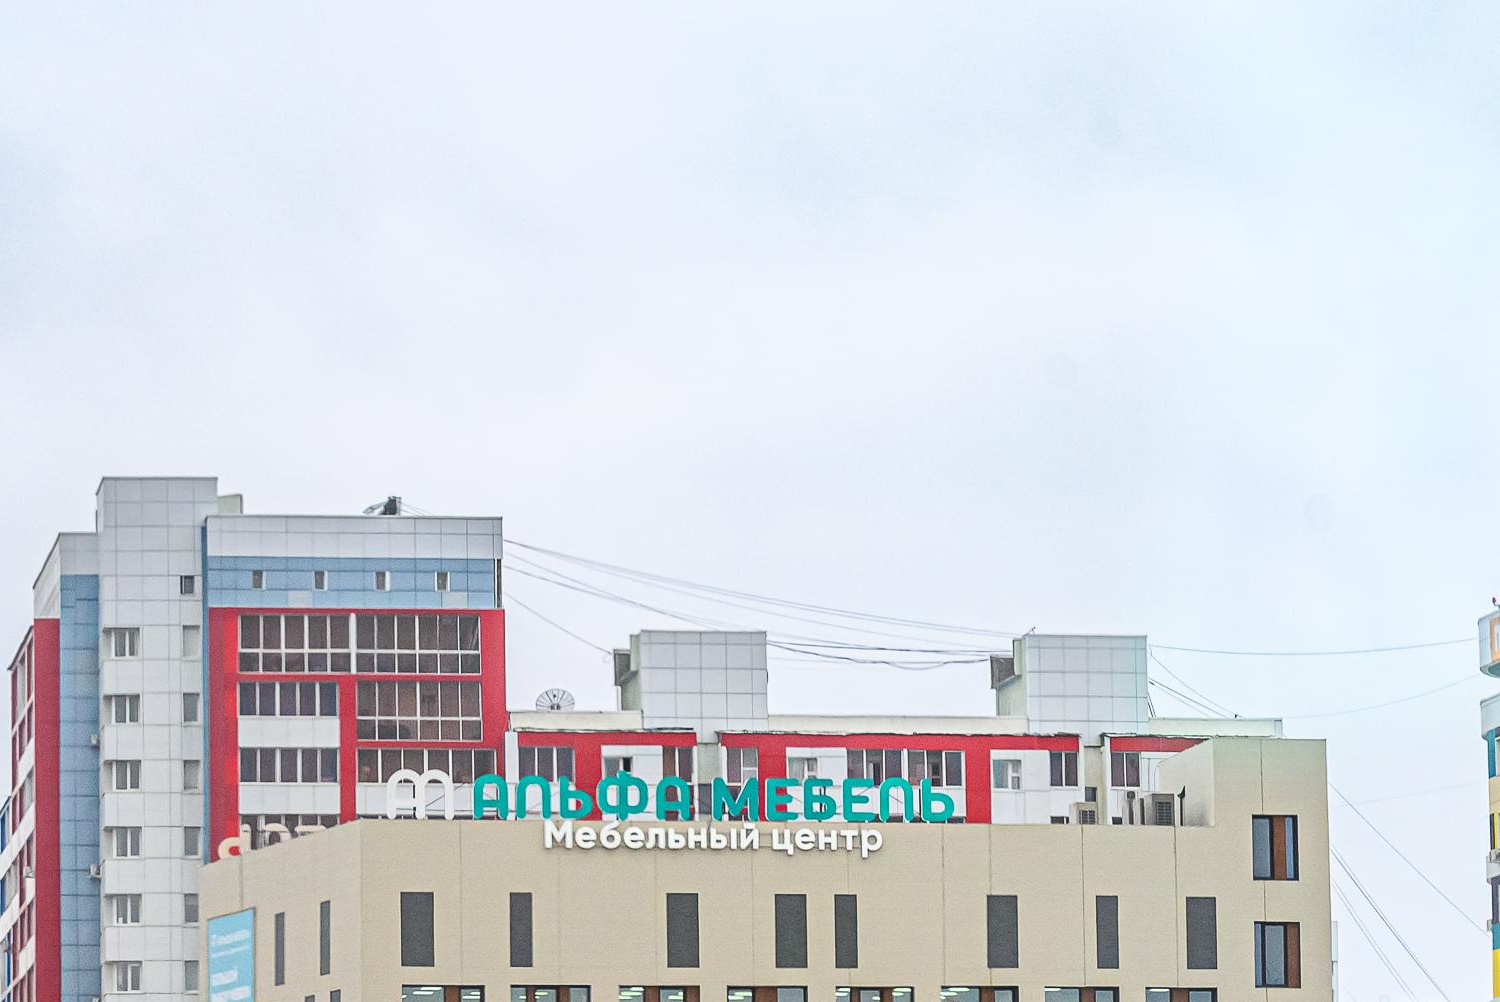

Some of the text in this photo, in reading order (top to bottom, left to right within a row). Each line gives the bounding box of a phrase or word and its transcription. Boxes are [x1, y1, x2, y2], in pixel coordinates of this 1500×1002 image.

[473, 770, 956, 823] АЛЬФА МЕБЕЛЬ
[543, 818, 884, 859] Мебельный центр
